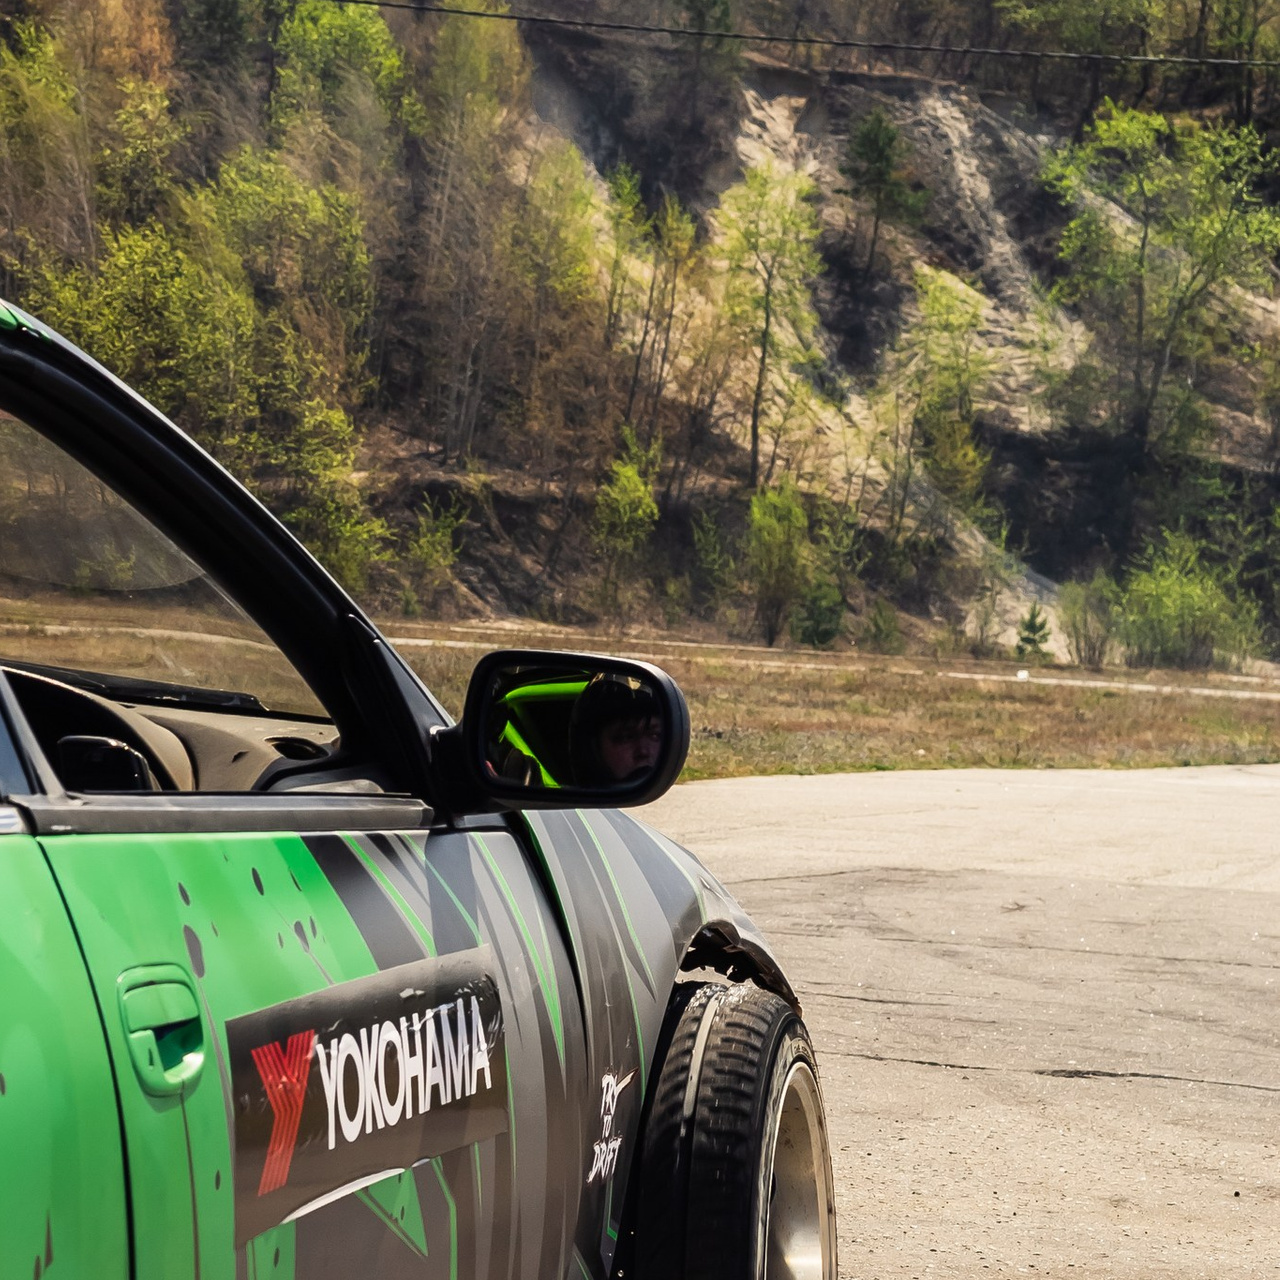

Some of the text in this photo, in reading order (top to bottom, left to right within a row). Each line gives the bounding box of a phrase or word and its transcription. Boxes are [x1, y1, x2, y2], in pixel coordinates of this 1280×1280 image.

[315, 995, 492, 1150] YOKOHAMA
[601, 1072, 636, 1118] TRY
[602, 1114, 613, 1139] TO
[586, 1137, 622, 1183] DRIFT
